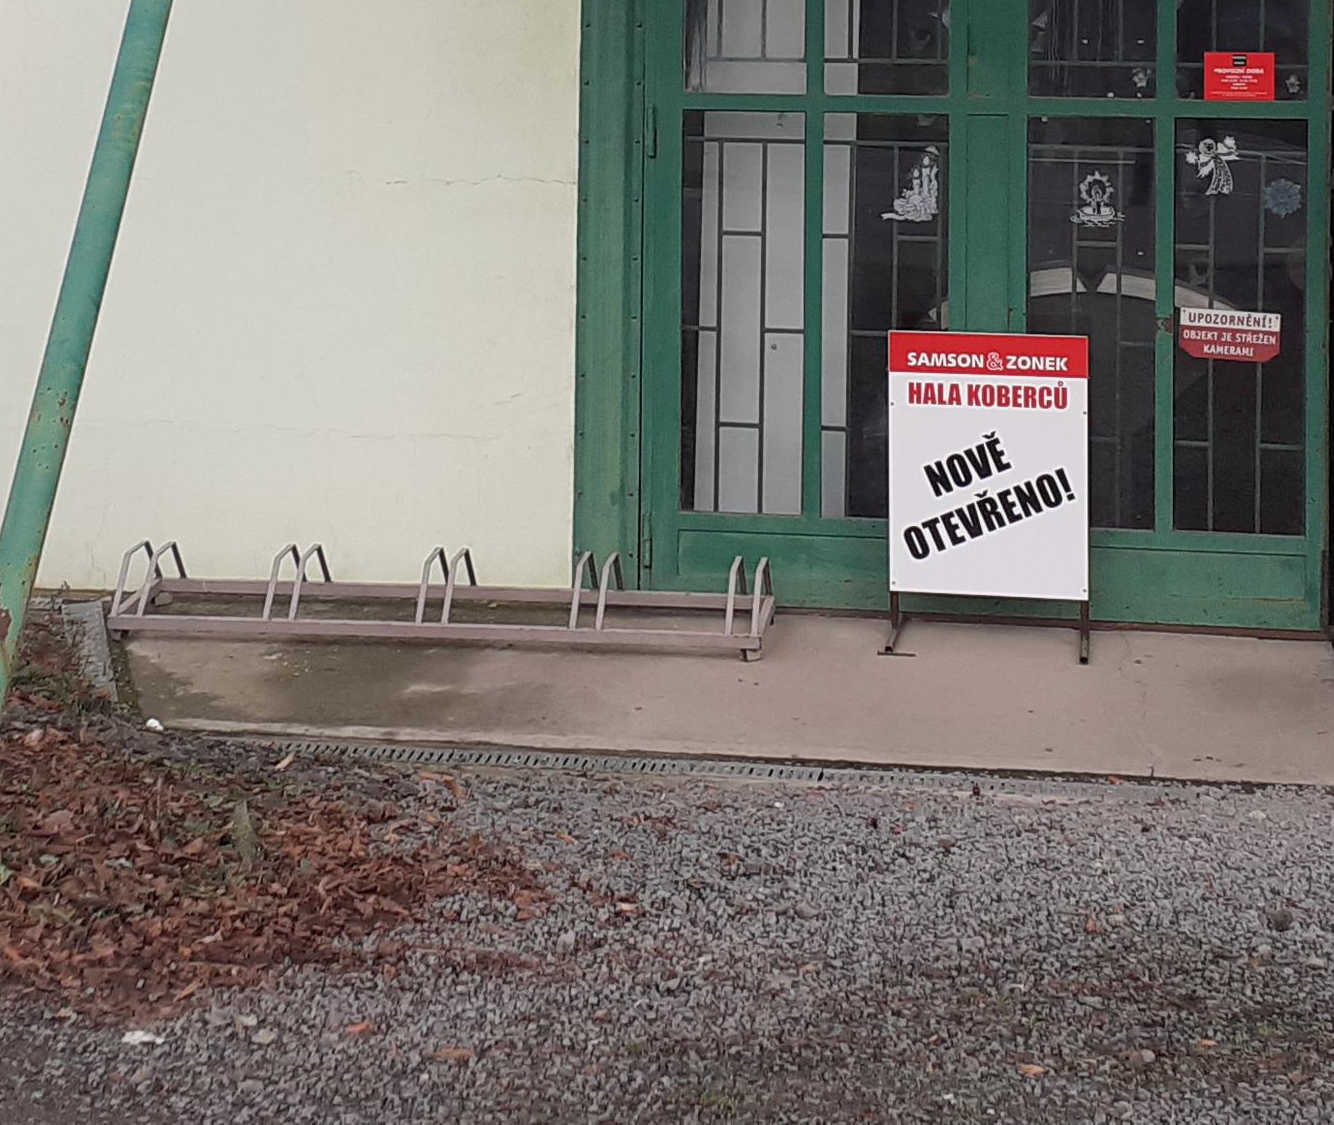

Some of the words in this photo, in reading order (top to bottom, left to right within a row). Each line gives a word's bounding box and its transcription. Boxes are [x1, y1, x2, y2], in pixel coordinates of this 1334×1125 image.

[1188, 312, 1273, 329] UPOZORNĚNÍ!
[1183, 329, 1218, 341] OBJEKT
[1221, 331, 1233, 342] JE
[1235, 332, 1276, 345] STŘEŽEN
[1203, 343, 1254, 357] KAMERAMI
[907, 352, 984, 368] SAMSON
[986, 351, 1004, 371] &
[1006, 355, 1068, 371] ZONEK
[908, 382, 962, 405] HALA
[967, 381, 1068, 409] KOBERCŮ
[923, 430, 1012, 497] NOVĚ
[903, 468, 1076, 560] OTEVŘENO!
